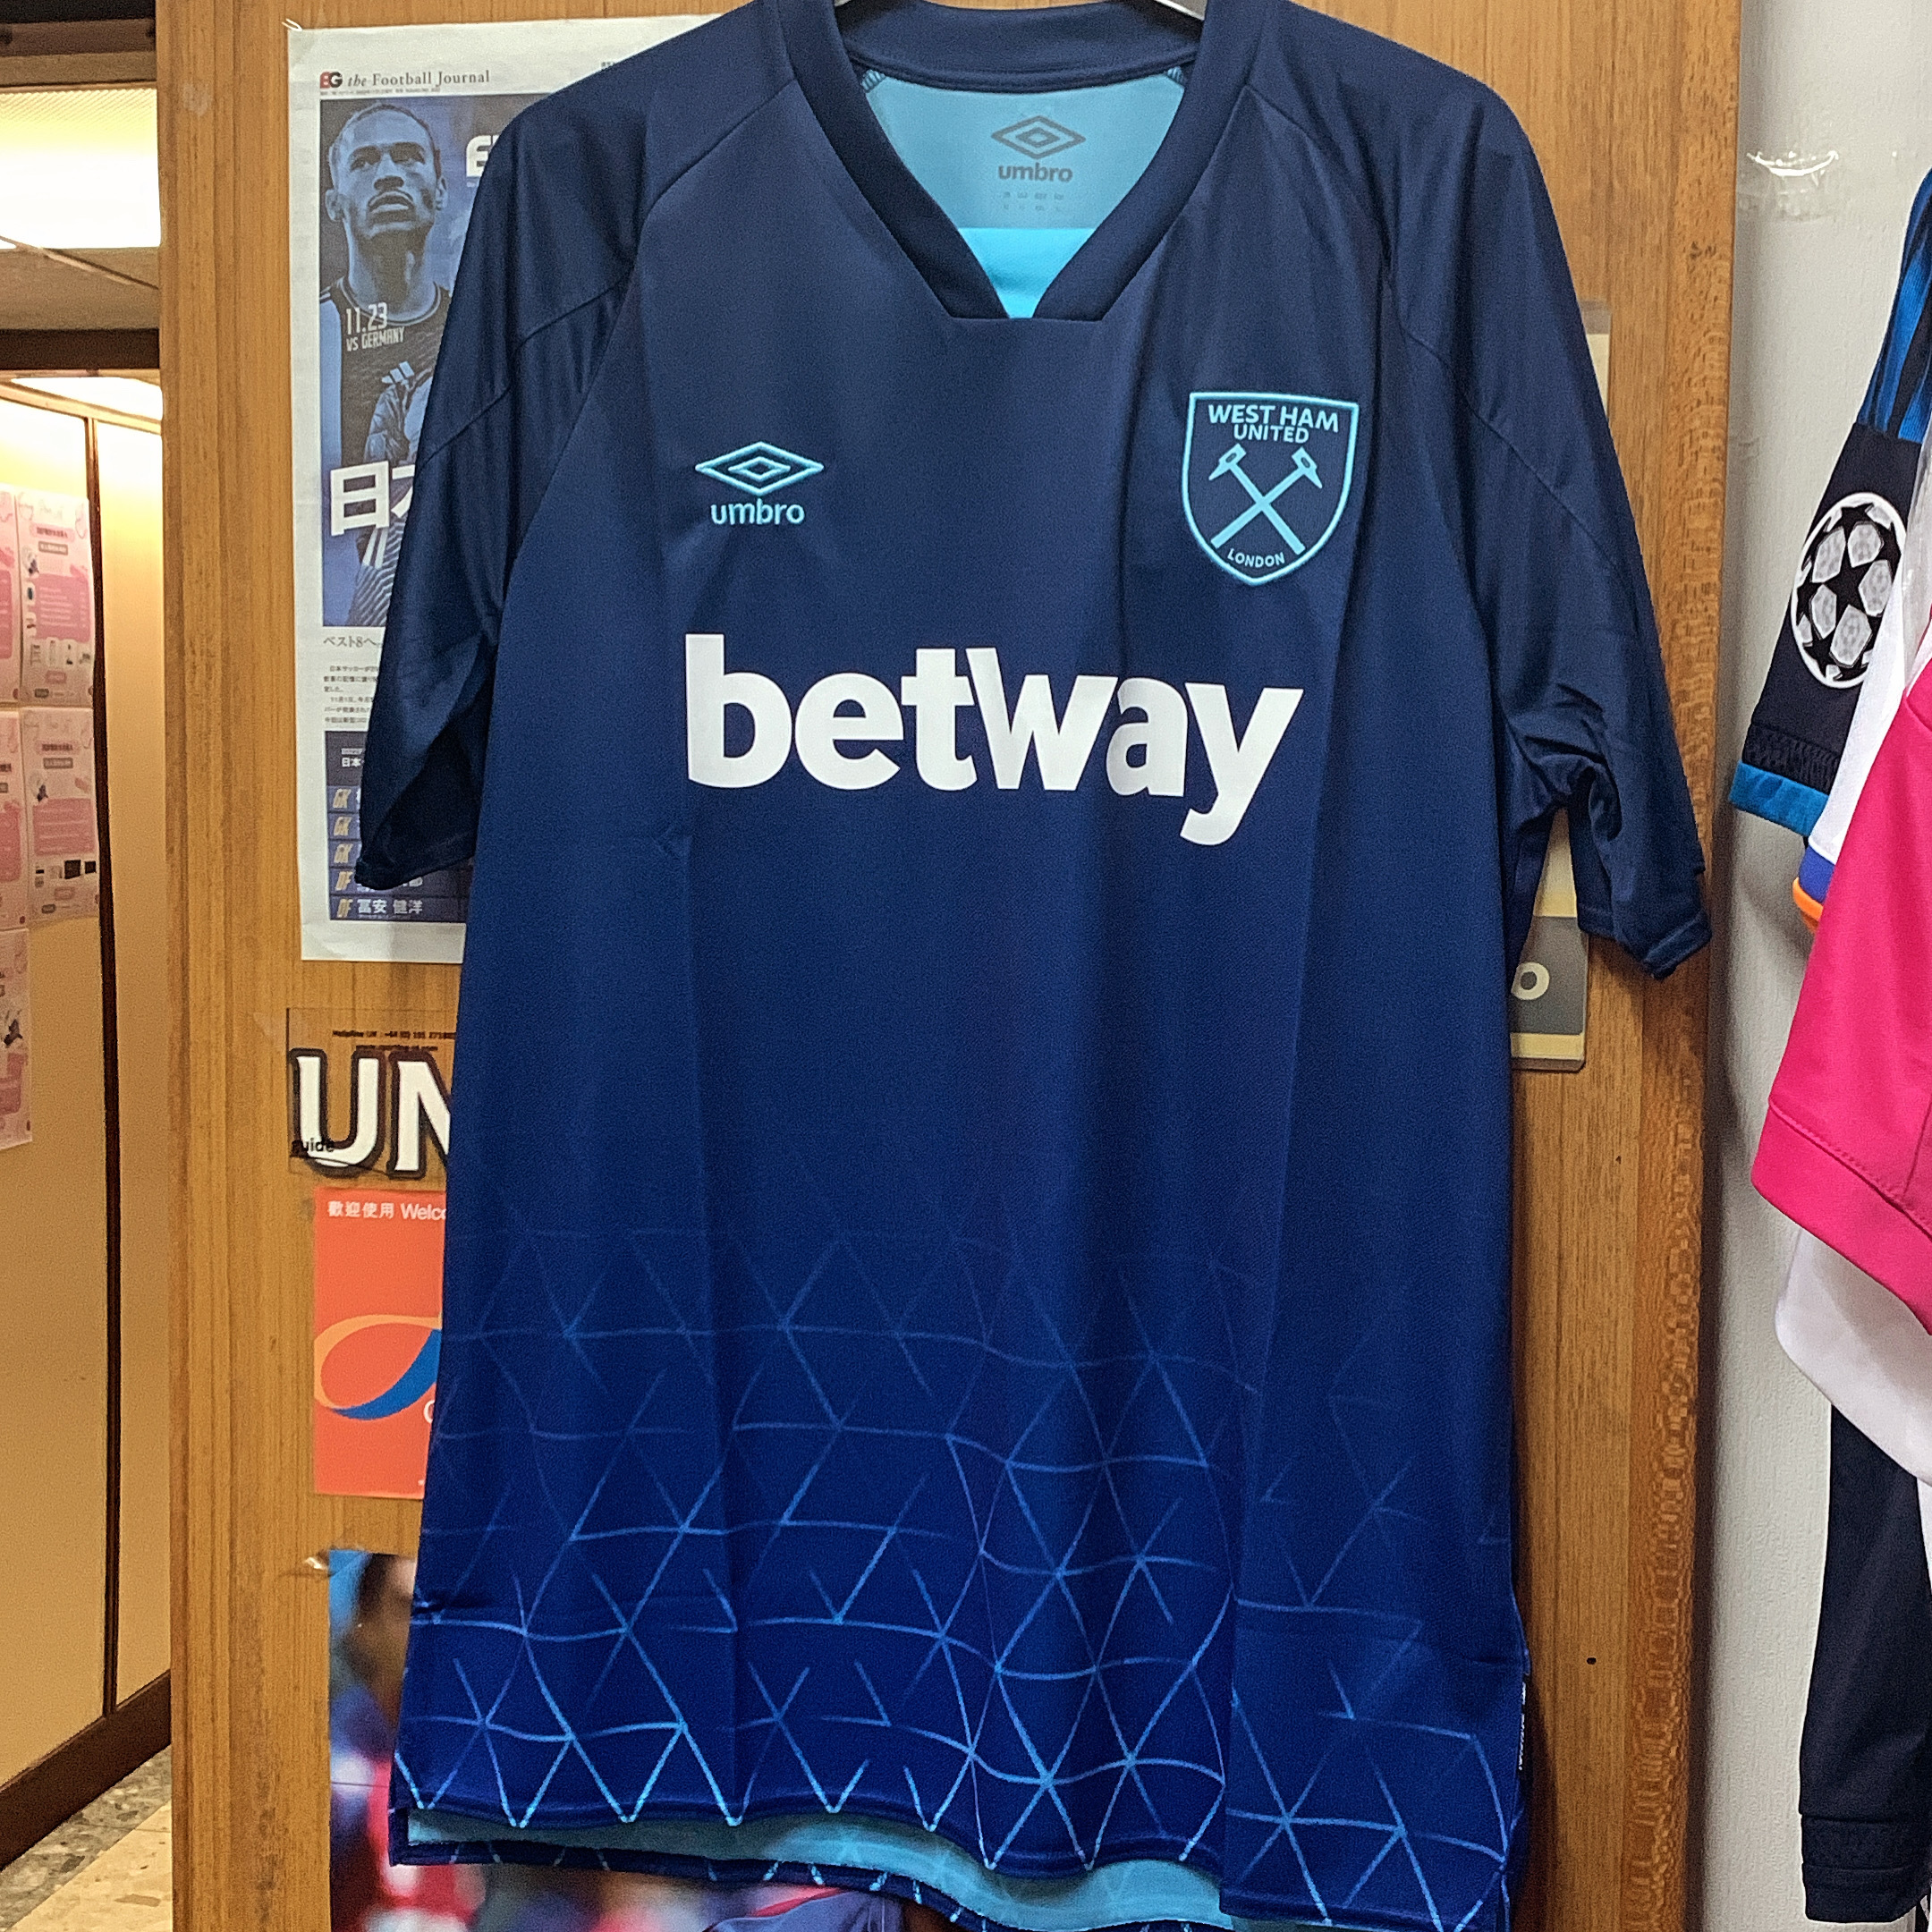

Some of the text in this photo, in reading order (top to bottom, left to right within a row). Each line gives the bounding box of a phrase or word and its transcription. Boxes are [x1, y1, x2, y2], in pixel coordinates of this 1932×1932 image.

[348, 74, 367, 87] the
[373, 72, 431, 86] Football
[435, 70, 489, 88] Journal
[998, 162, 1073, 182] umbro
[346, 302, 387, 335] 11.23
[346, 326, 404, 352] VS GERMANY
[1208, 404, 1338, 433] WEST HAM
[1233, 424, 1309, 444] UNITED
[710, 498, 804, 525] umbro
[1227, 547, 1285, 568] LONDON
[685, 633, 1304, 846] betway
